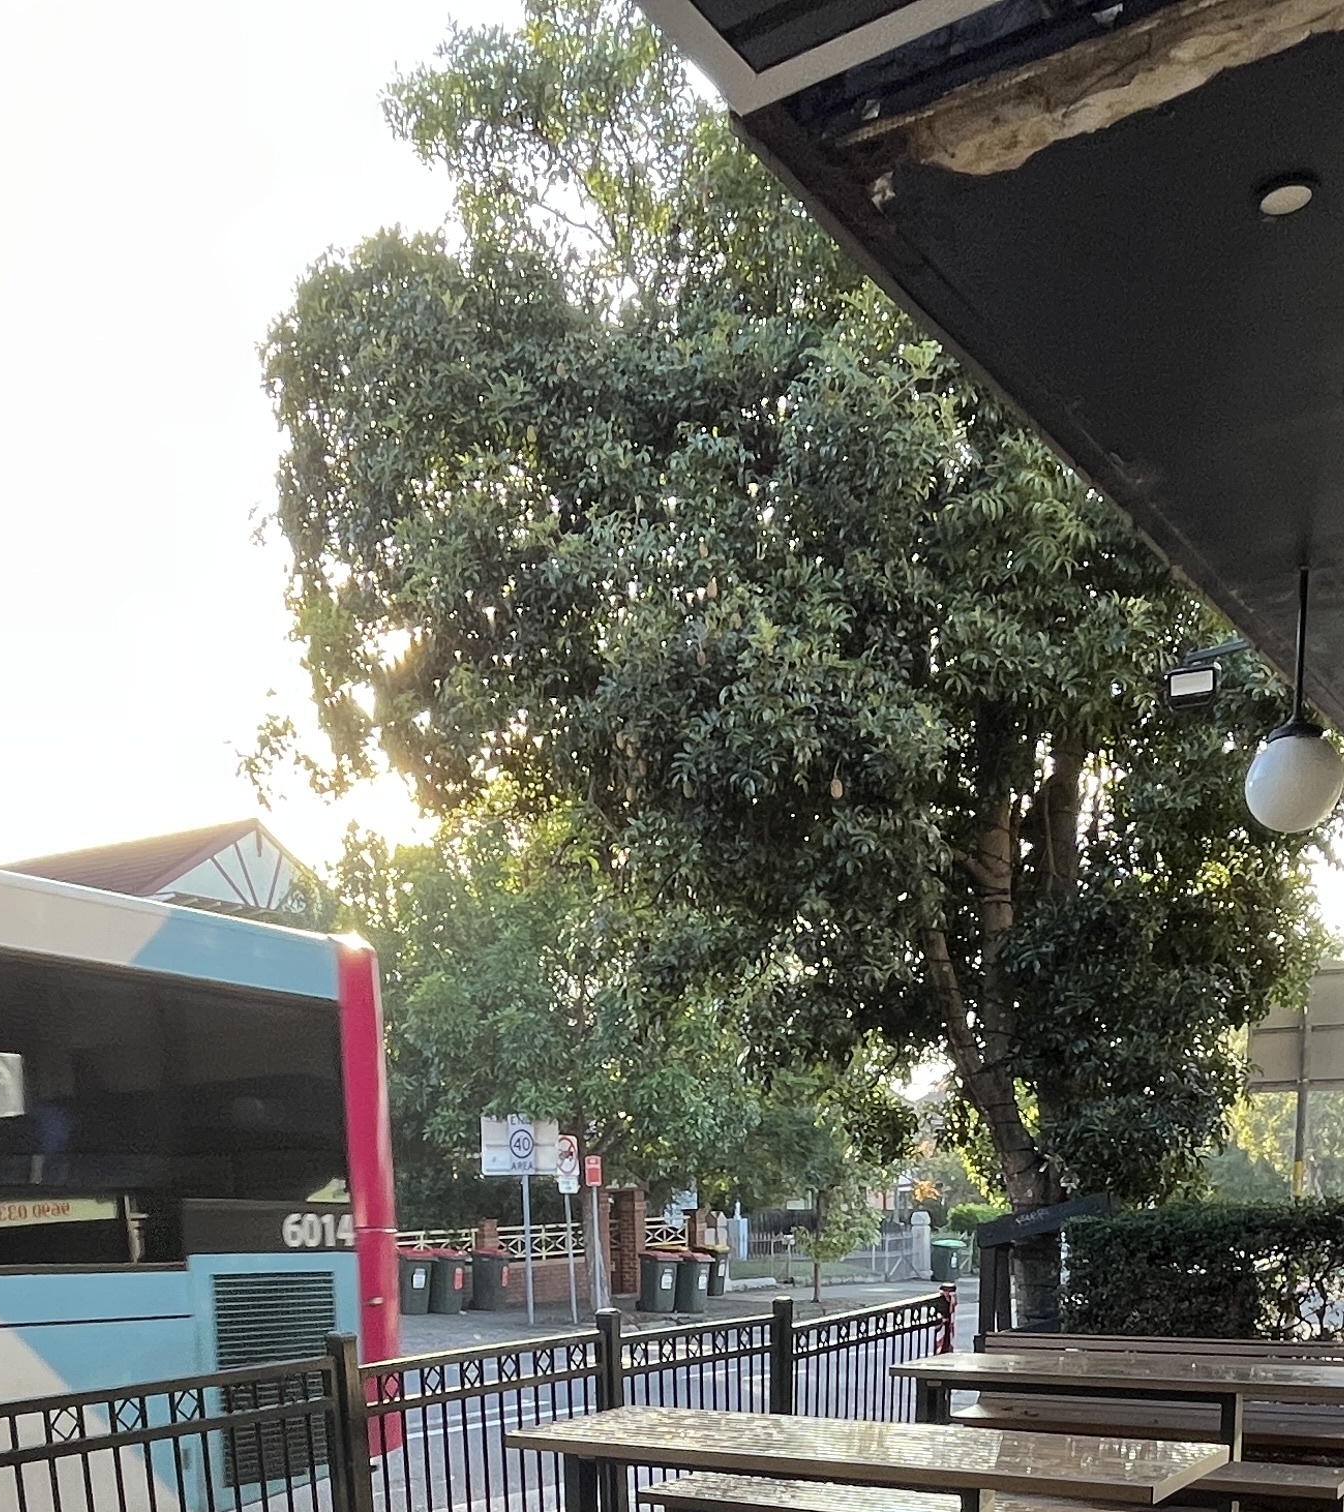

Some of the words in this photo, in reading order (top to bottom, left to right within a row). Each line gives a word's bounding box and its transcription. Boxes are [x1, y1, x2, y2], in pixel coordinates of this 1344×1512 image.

[513, 1136, 531, 1151] 40
[510, 1161, 534, 1171] AREA
[282, 1212, 356, 1247] 6014
